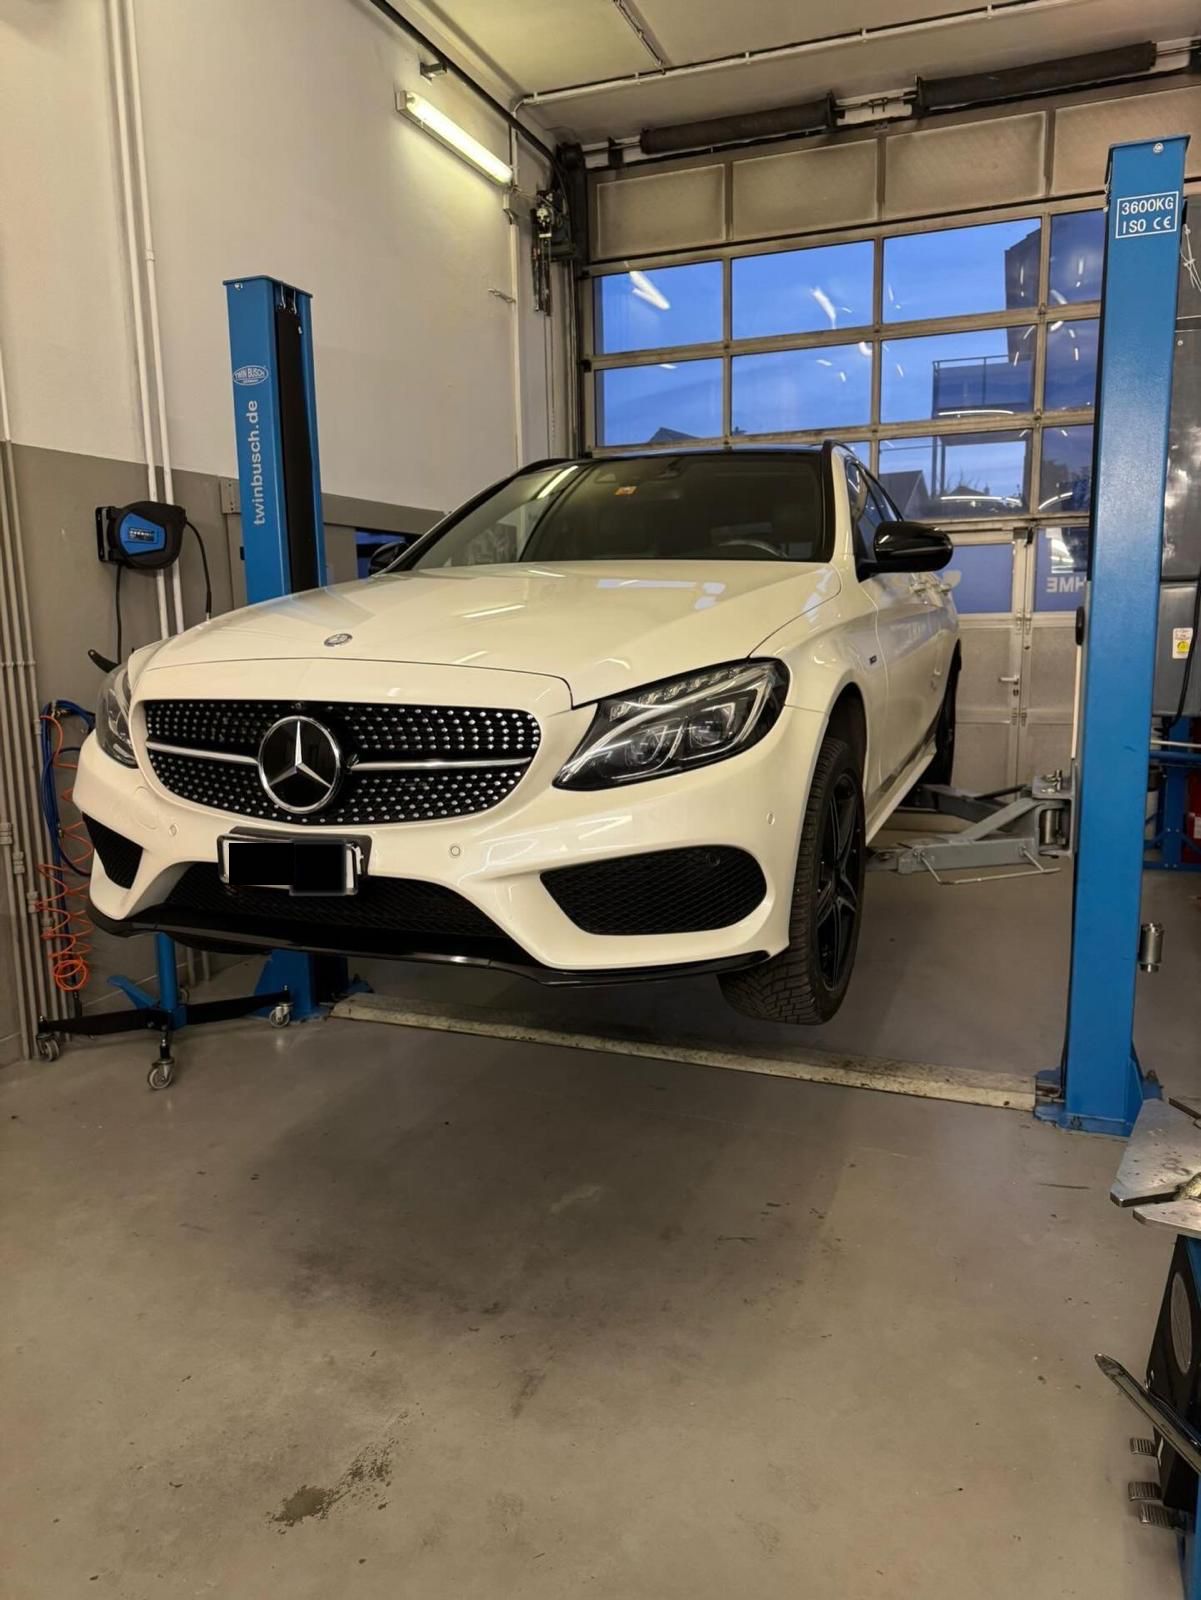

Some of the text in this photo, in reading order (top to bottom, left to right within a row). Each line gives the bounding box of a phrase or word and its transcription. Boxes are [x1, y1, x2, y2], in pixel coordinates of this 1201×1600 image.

[1121, 196, 1174, 215] 3600KG
[1122, 218, 1146, 234] ISO
[234, 366, 265, 379] TWIN BUSCH
[246, 400, 265, 525] twinbusch.de
